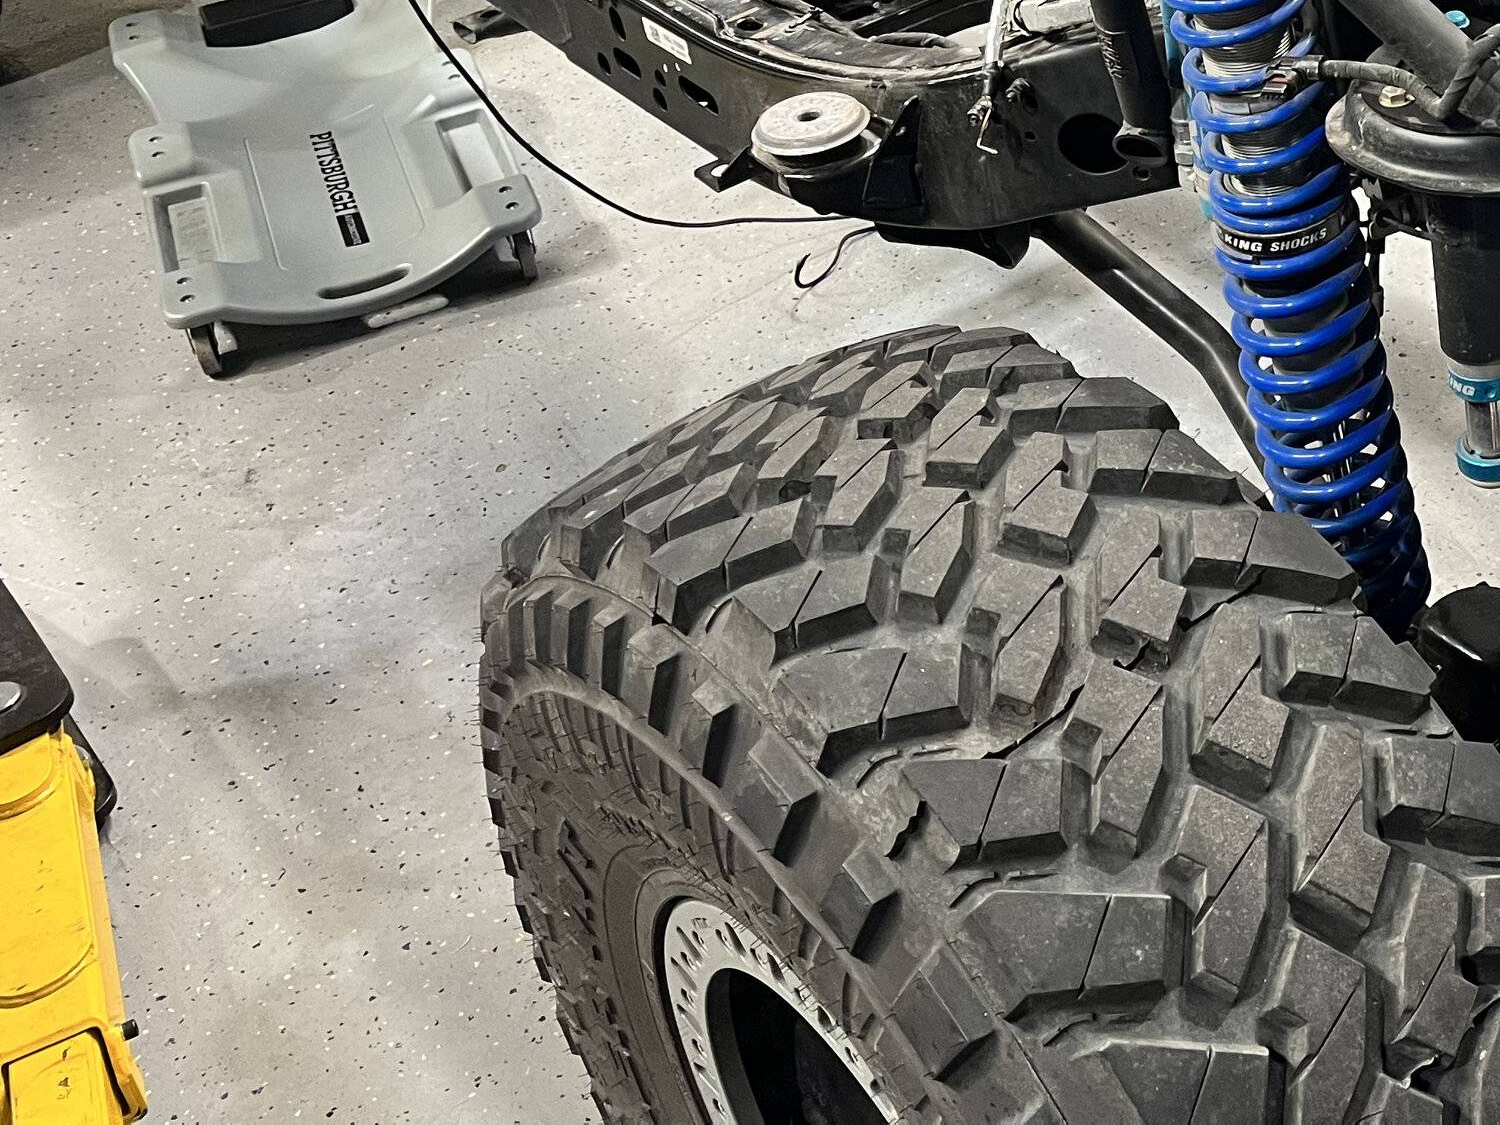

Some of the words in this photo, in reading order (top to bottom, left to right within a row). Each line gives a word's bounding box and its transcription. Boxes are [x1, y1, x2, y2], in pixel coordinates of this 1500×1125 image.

[309, 131, 359, 213] PITTSBURGH
[1224, 235, 1262, 252] KING
[1270, 228, 1327, 252] SHOCKS
[1449, 376, 1476, 396] ING
